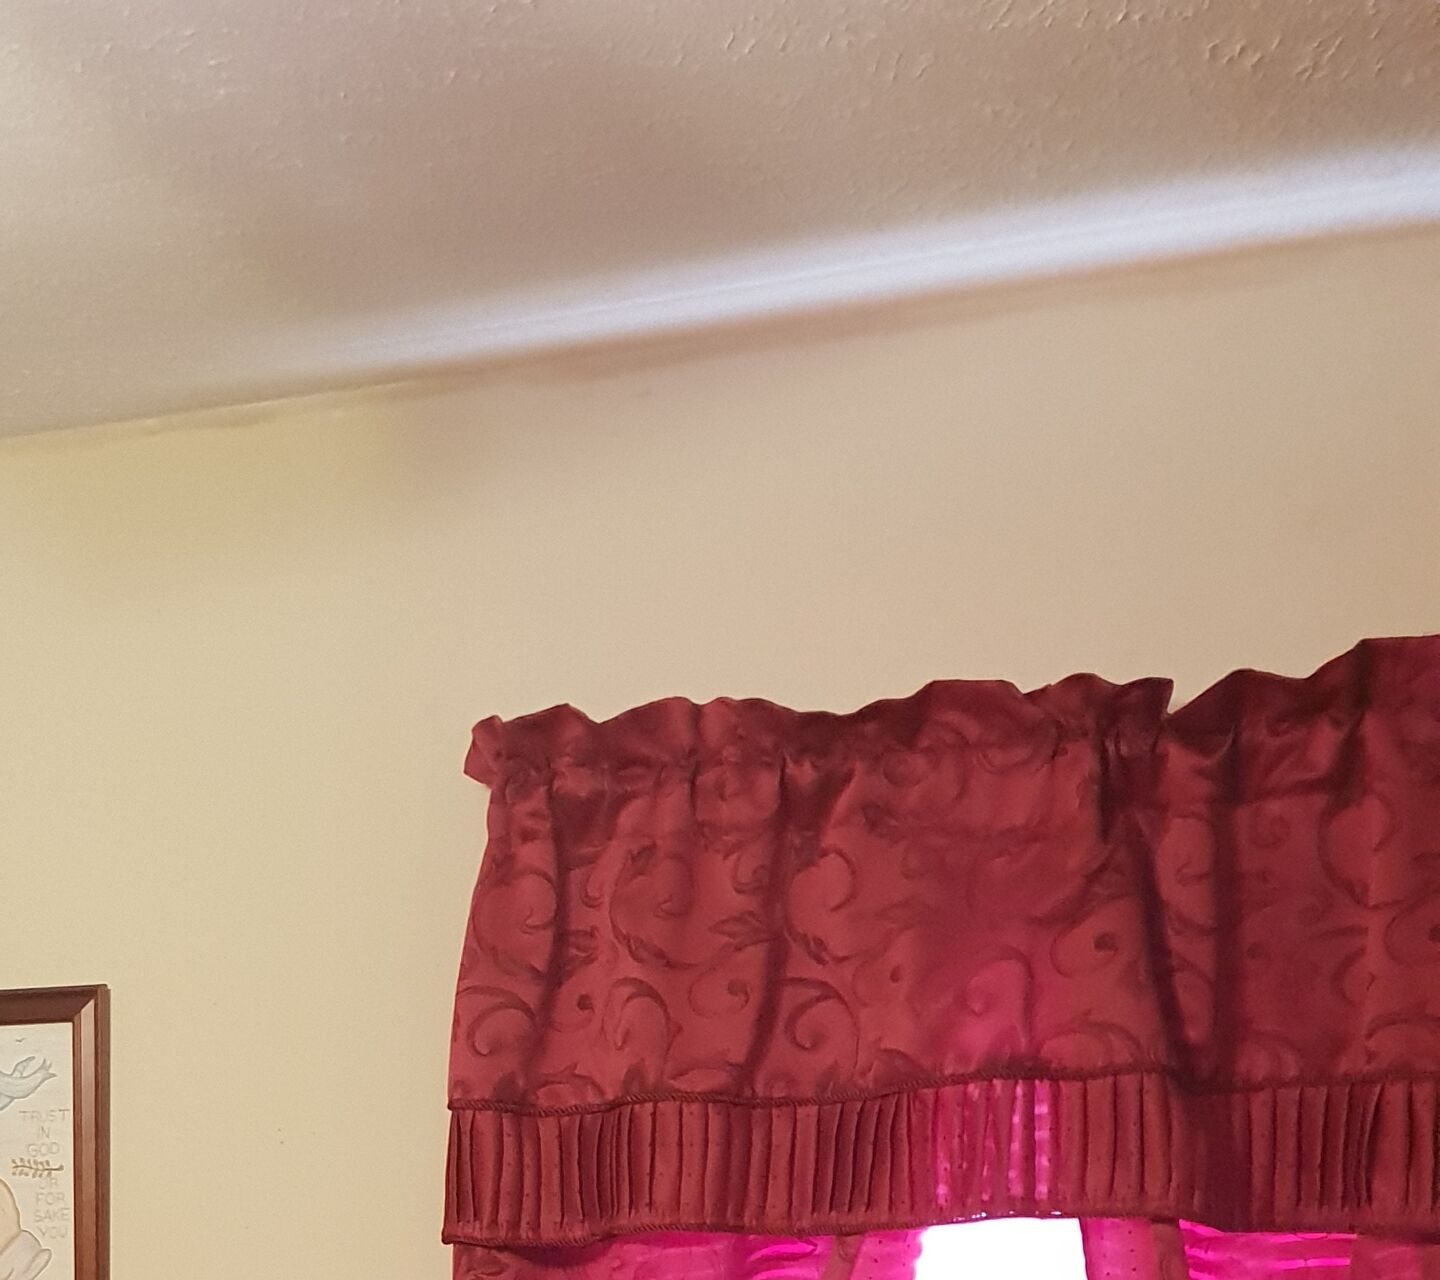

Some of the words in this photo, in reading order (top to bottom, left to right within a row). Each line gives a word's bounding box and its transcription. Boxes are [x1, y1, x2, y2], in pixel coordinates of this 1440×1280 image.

[18, 1108, 71, 1122] TRUST
[27, 1142, 60, 1158] GOD
[35, 1191, 66, 1205] FOR
[33, 1207, 71, 1223] SAKE
[36, 1225, 69, 1240] YOU
